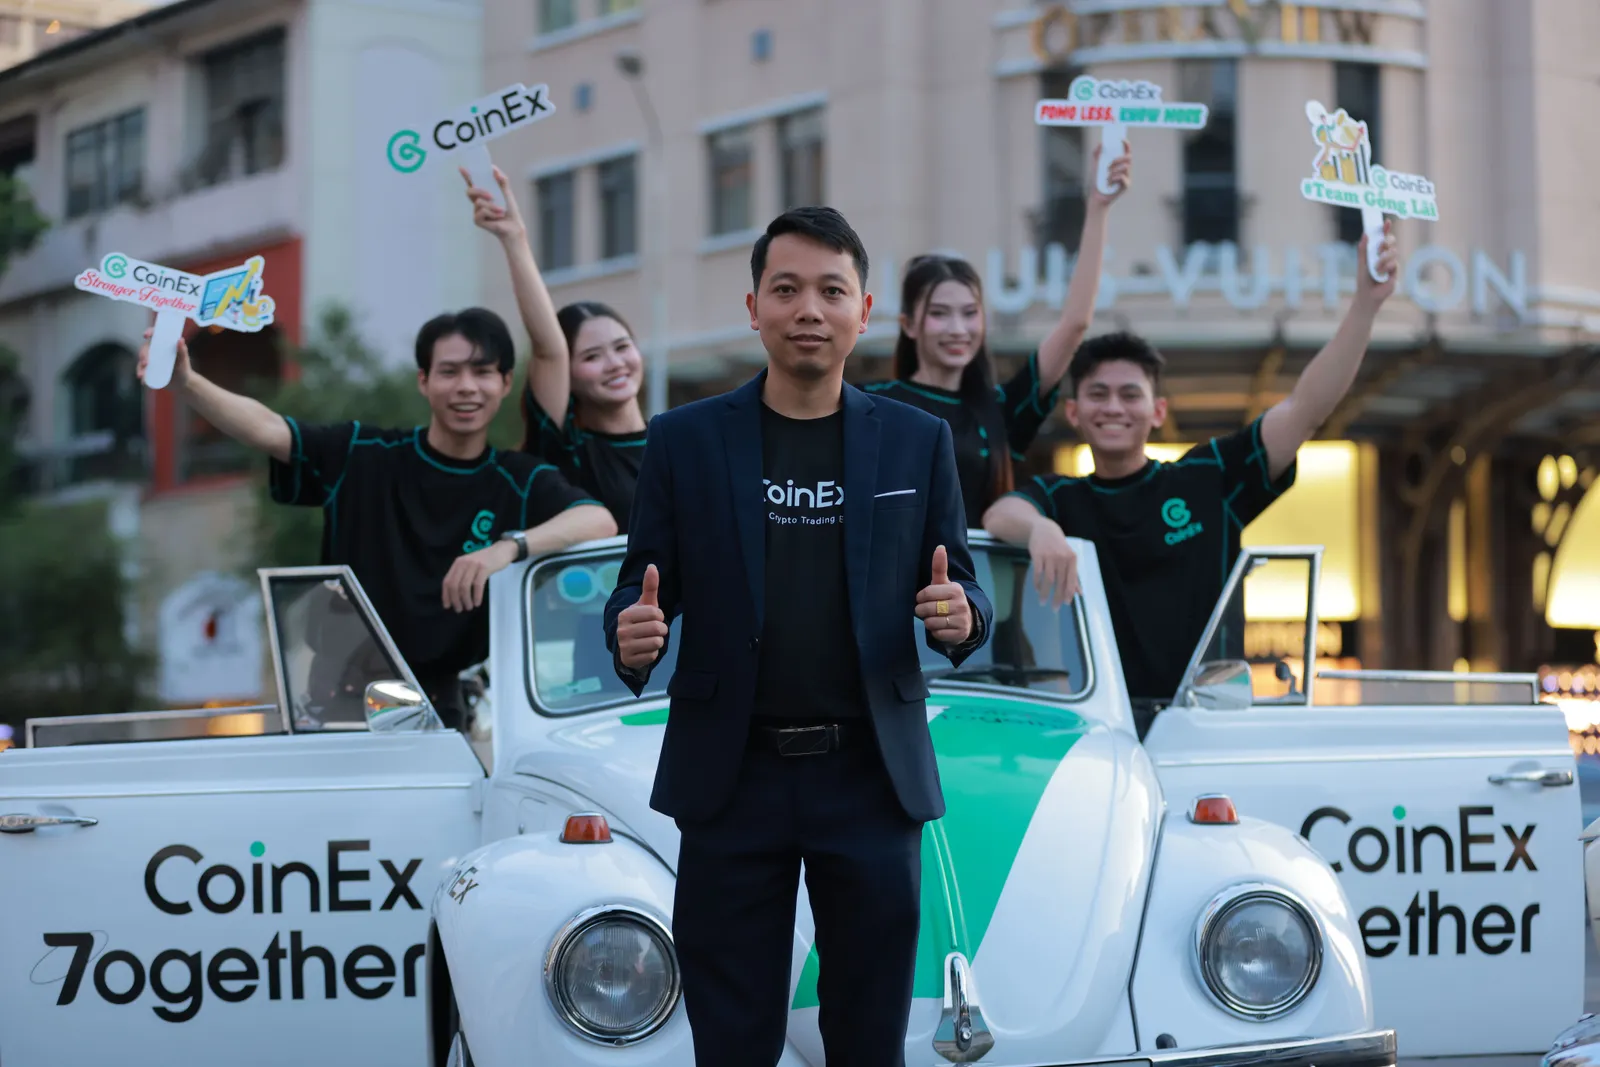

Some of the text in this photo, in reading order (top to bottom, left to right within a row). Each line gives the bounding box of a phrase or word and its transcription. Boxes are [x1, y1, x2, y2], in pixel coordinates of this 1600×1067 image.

[1098, 79, 1156, 100] CoinEx
[433, 90, 547, 150] CoinEx
[1390, 174, 1433, 195] CoinEx
[78, 271, 197, 313] Stronger Together
[133, 265, 202, 297] CoinEx
[1155, 240, 1528, 320] VUITON
[768, 511, 798, 525] Crypto
[800, 515, 836, 525] Trading
[1299, 804, 1539, 875] CoinEx
[143, 838, 424, 915] CoinEx
[1357, 890, 1541, 959] ether
